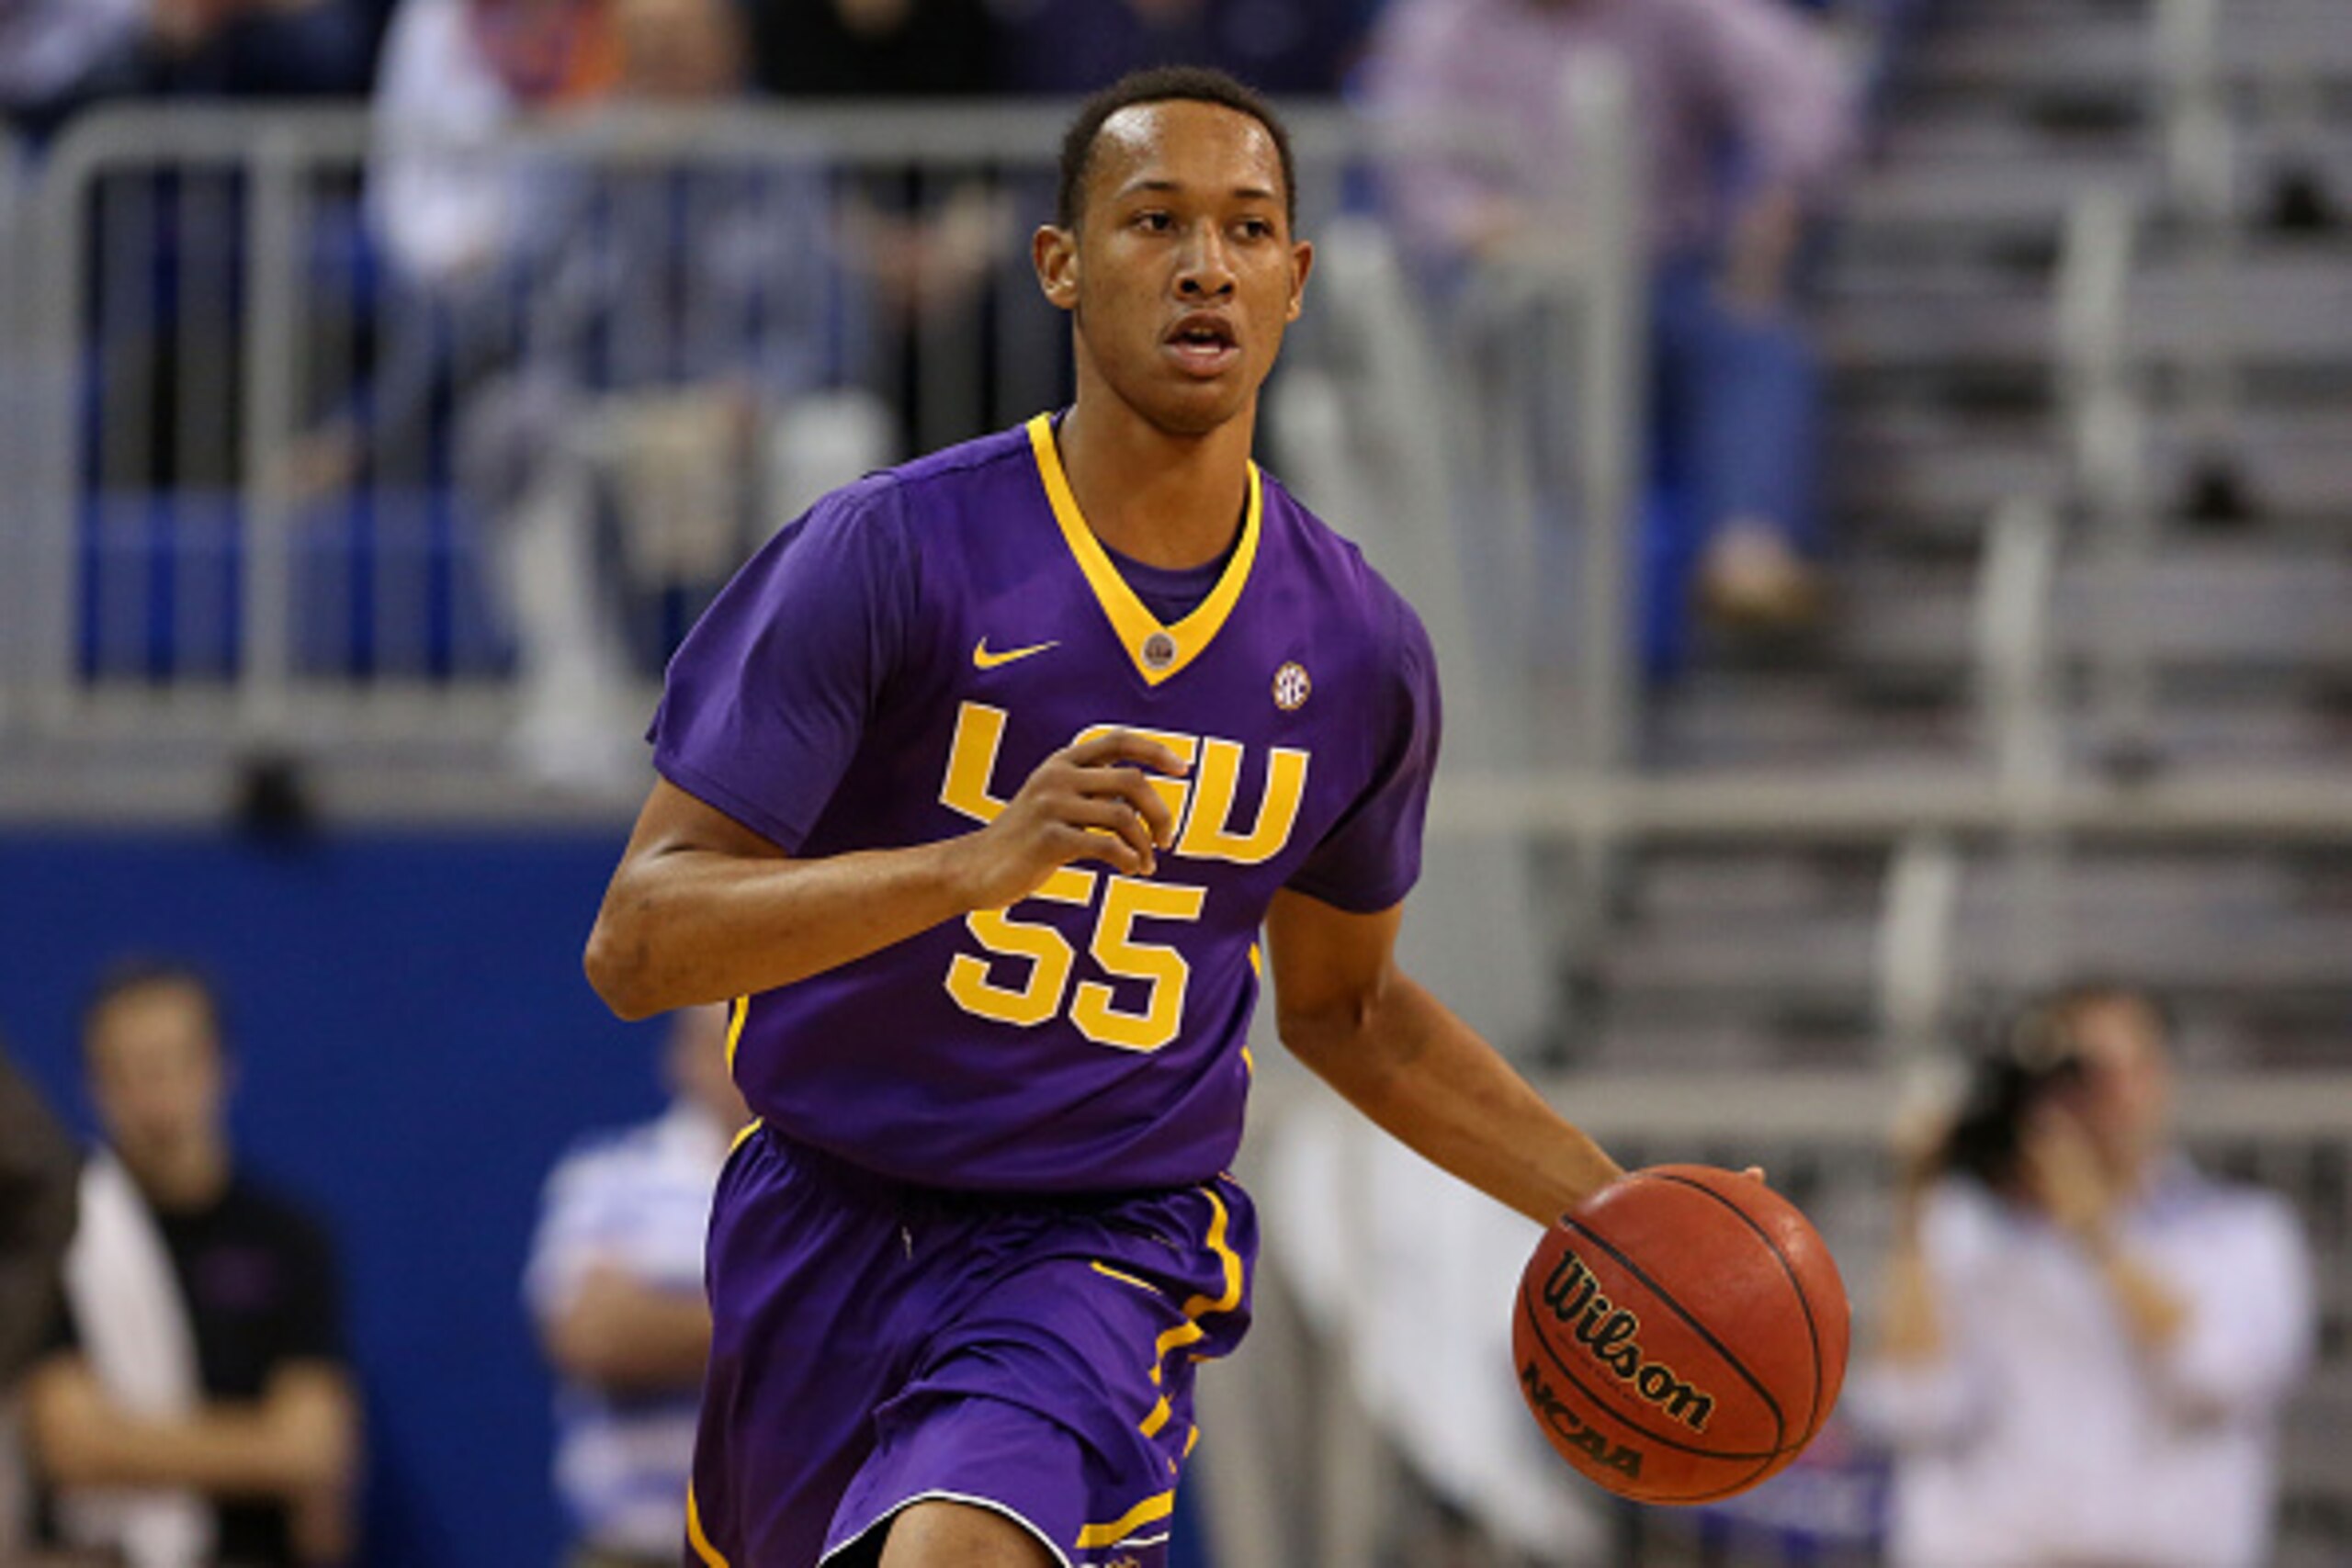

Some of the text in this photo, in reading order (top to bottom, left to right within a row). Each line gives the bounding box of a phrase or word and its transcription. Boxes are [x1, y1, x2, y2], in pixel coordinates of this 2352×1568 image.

[944, 867, 1208, 1053] 55
[1522, 1361, 1644, 1481] NCAA
[1543, 1248, 1715, 1434] Wilson
